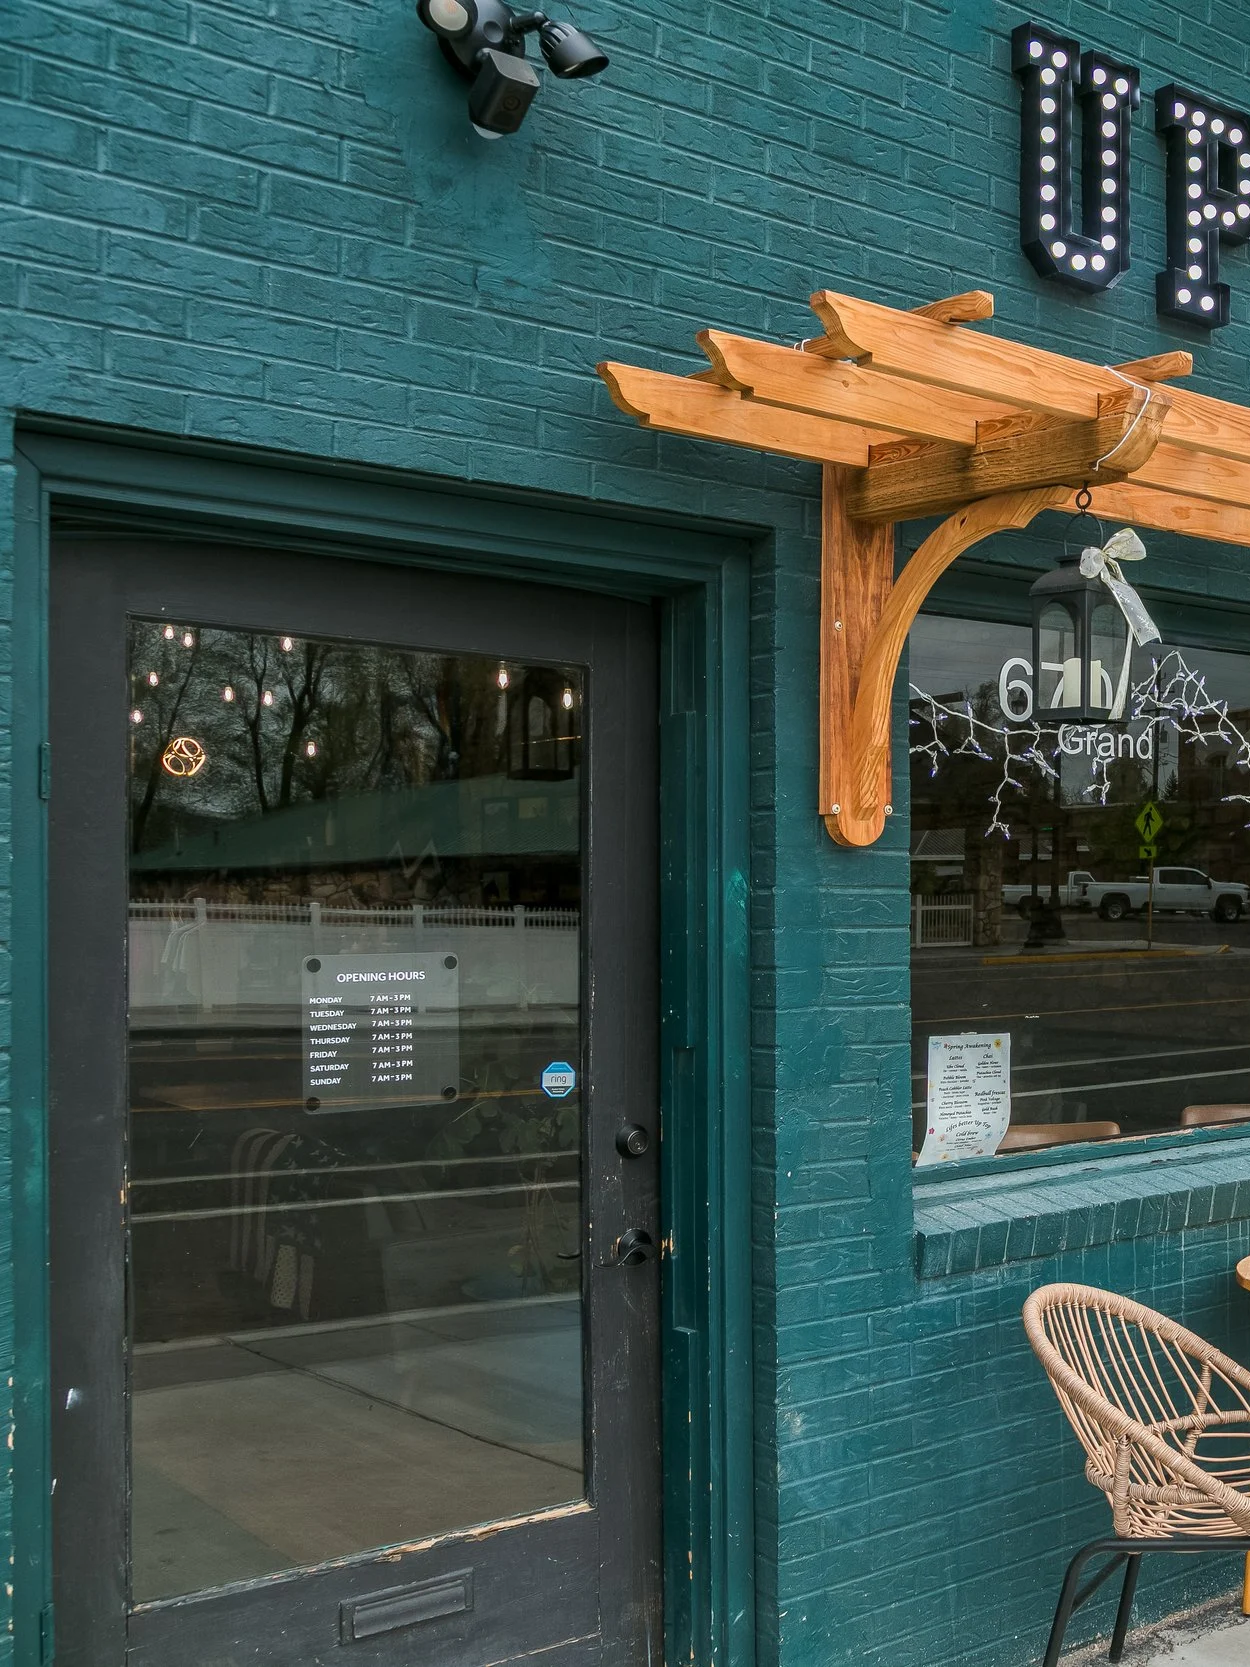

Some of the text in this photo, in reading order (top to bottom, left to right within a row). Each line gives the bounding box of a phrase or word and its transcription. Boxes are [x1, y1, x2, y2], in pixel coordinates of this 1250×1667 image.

[1058, 724, 1153, 759] Grand
[337, 971, 426, 983] OPENING HOURS
[309, 996, 343, 1004] MONDAY
[310, 1010, 345, 1018] TUESDAY
[310, 1023, 357, 1031] WEDNESDAY
[310, 1037, 350, 1045] THURSDAY
[310, 1051, 338, 1059] FRIDAY
[310, 1063, 349, 1072] SATURDAY
[310, 1078, 341, 1086] SUNDAY
[551, 1075, 567, 1085] ring
